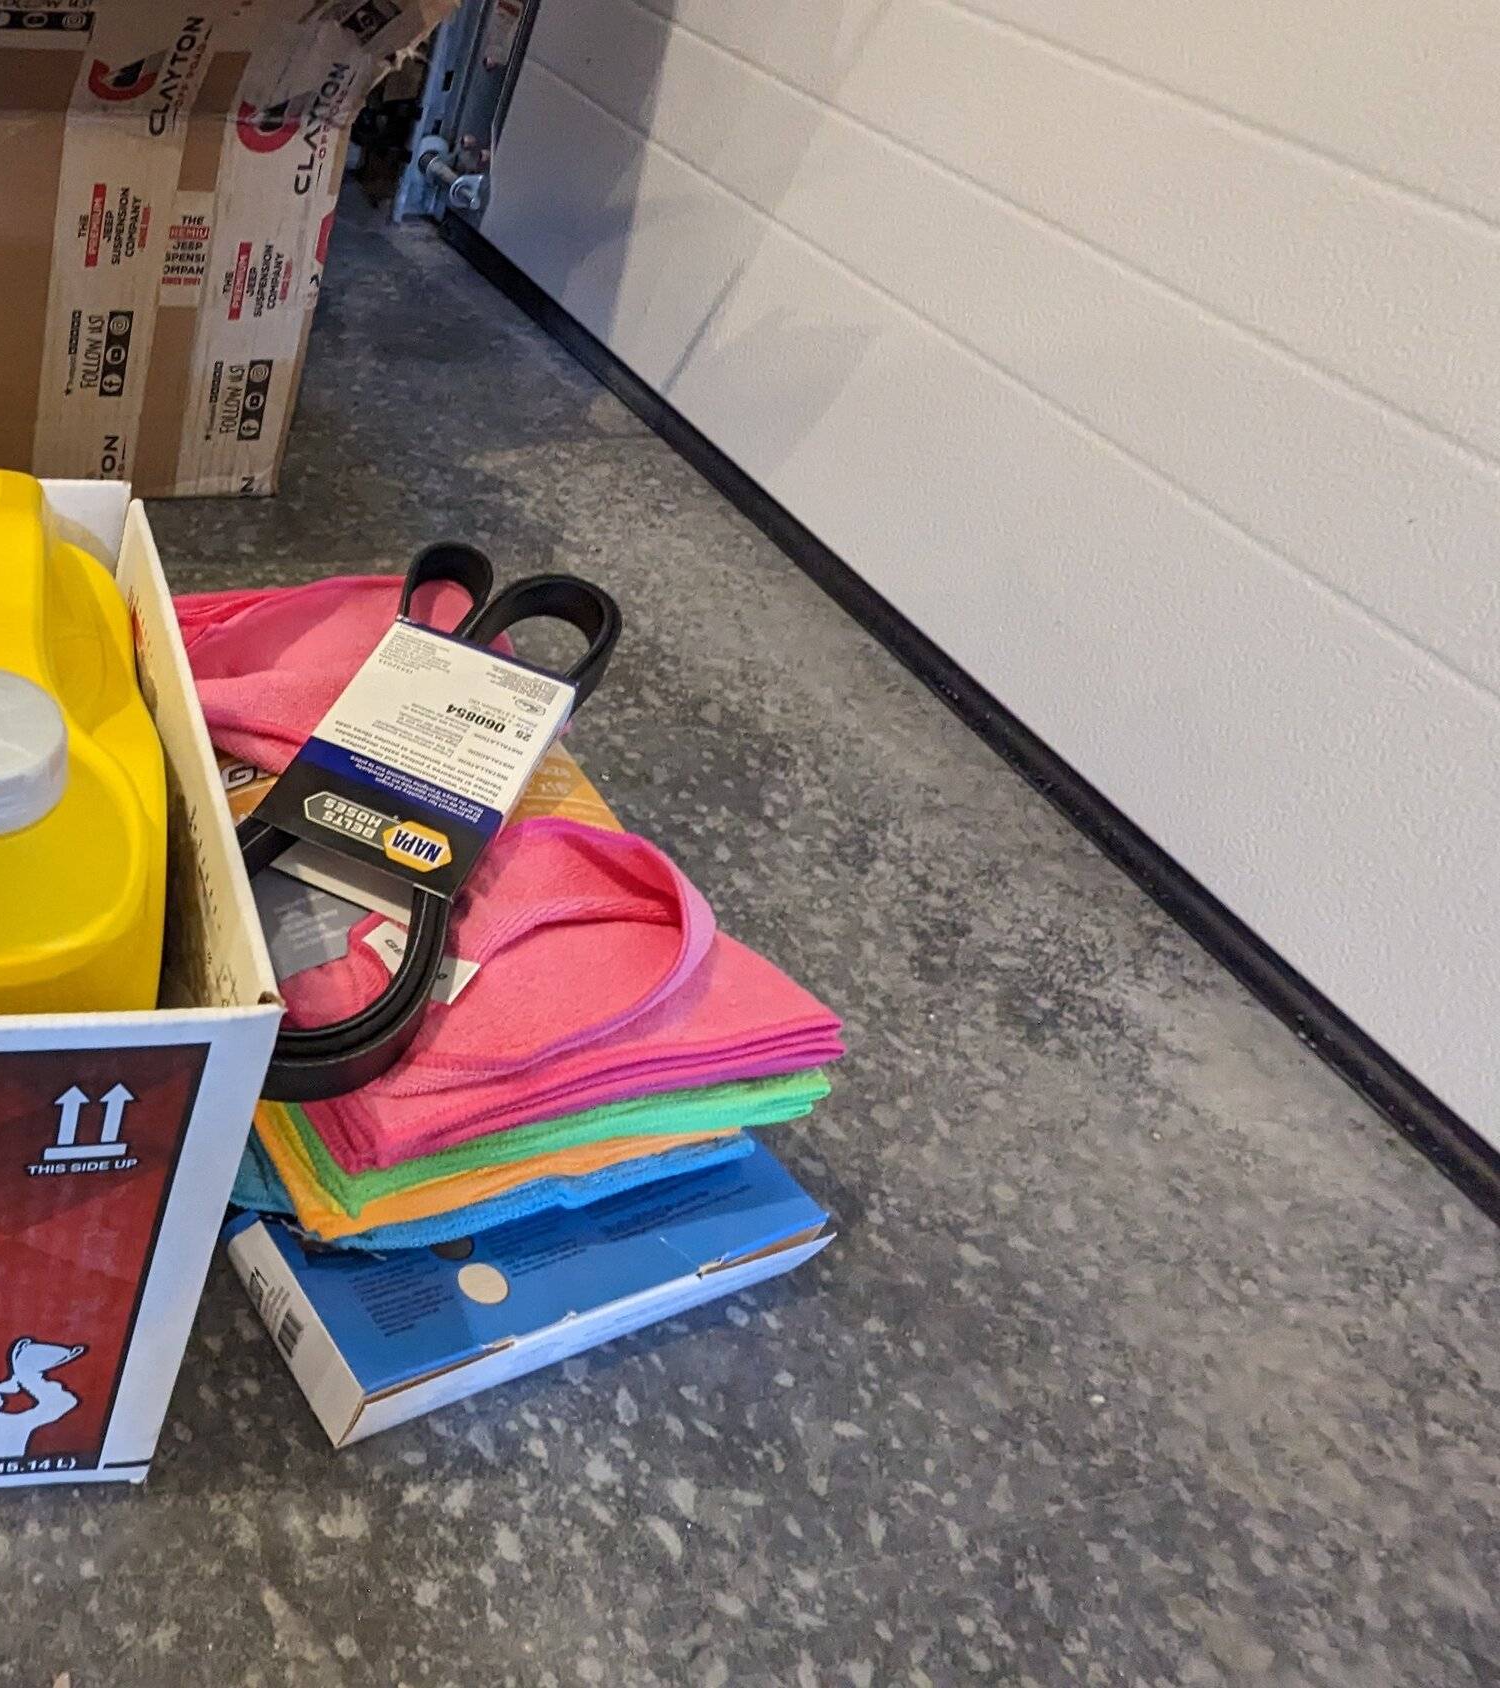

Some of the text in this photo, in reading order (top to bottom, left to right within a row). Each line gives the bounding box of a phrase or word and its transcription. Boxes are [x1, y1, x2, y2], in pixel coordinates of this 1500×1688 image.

[149, 17, 204, 136] CLAYTON
[294, 62, 350, 195] CLAYTON
[78, 214, 89, 239] THE
[103, 209, 114, 243] JEEP
[111, 187, 130, 265] SUSPENSION
[125, 196, 142, 258] COMPANY
[169, 226, 209, 239] REMIU
[181, 215, 206, 226] THE
[164, 251, 206, 263] SPENSI
[172, 241, 204, 251] JEEP
[163, 265, 205, 276] OMPAN
[222, 271, 234, 295] THE
[245, 266, 258, 298] JEEP
[253, 244, 274, 318] SUSPENSION
[266, 252, 285, 310] COMPANY
[80, 337, 102, 390] FOLLOW
[219, 386, 243, 435] FOLLOW
[444, 702, 507, 735] 060854
[321, 809, 378, 840] BELTS
[323, 796, 383, 830] HOSES
[391, 829, 444, 864] NAPA
[27, 1157, 139, 1176] THIS SIDE UP
[55, 1456, 78, 1471] L)
